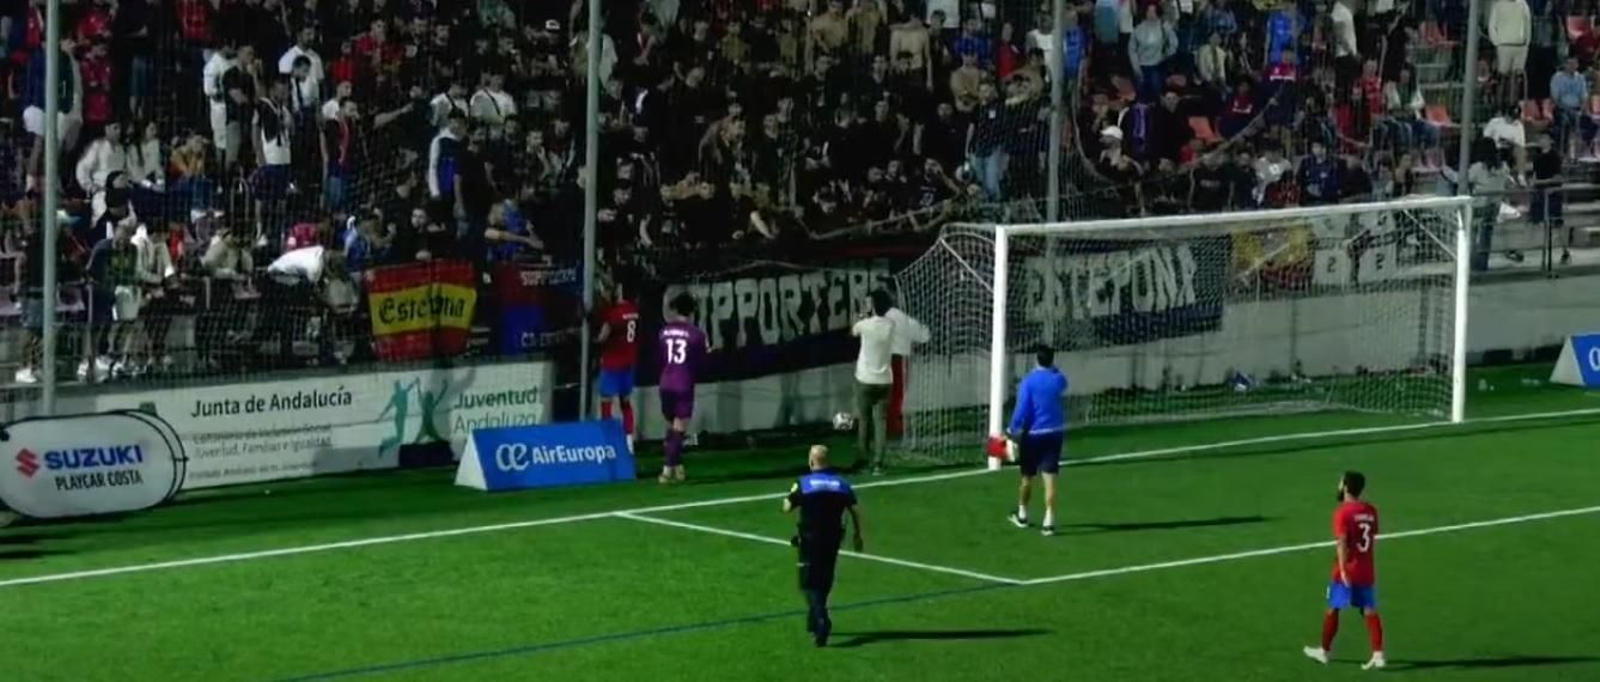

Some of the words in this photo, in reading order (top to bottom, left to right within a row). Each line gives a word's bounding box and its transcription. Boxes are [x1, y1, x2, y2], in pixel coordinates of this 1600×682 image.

[626, 320, 637, 344] 8
[665, 338, 687, 365] 13
[191, 399, 241, 418] Junta
[245, 394, 266, 413] de
[269, 384, 353, 412] Andalucía
[453, 386, 539, 409] Juventud
[43, 444, 144, 471] SUZUKI
[532, 444, 617, 465] AirEuropa
[55, 471, 105, 491] PLAYCAR
[107, 469, 144, 487] COSTA
[1356, 522, 1372, 553] 3
